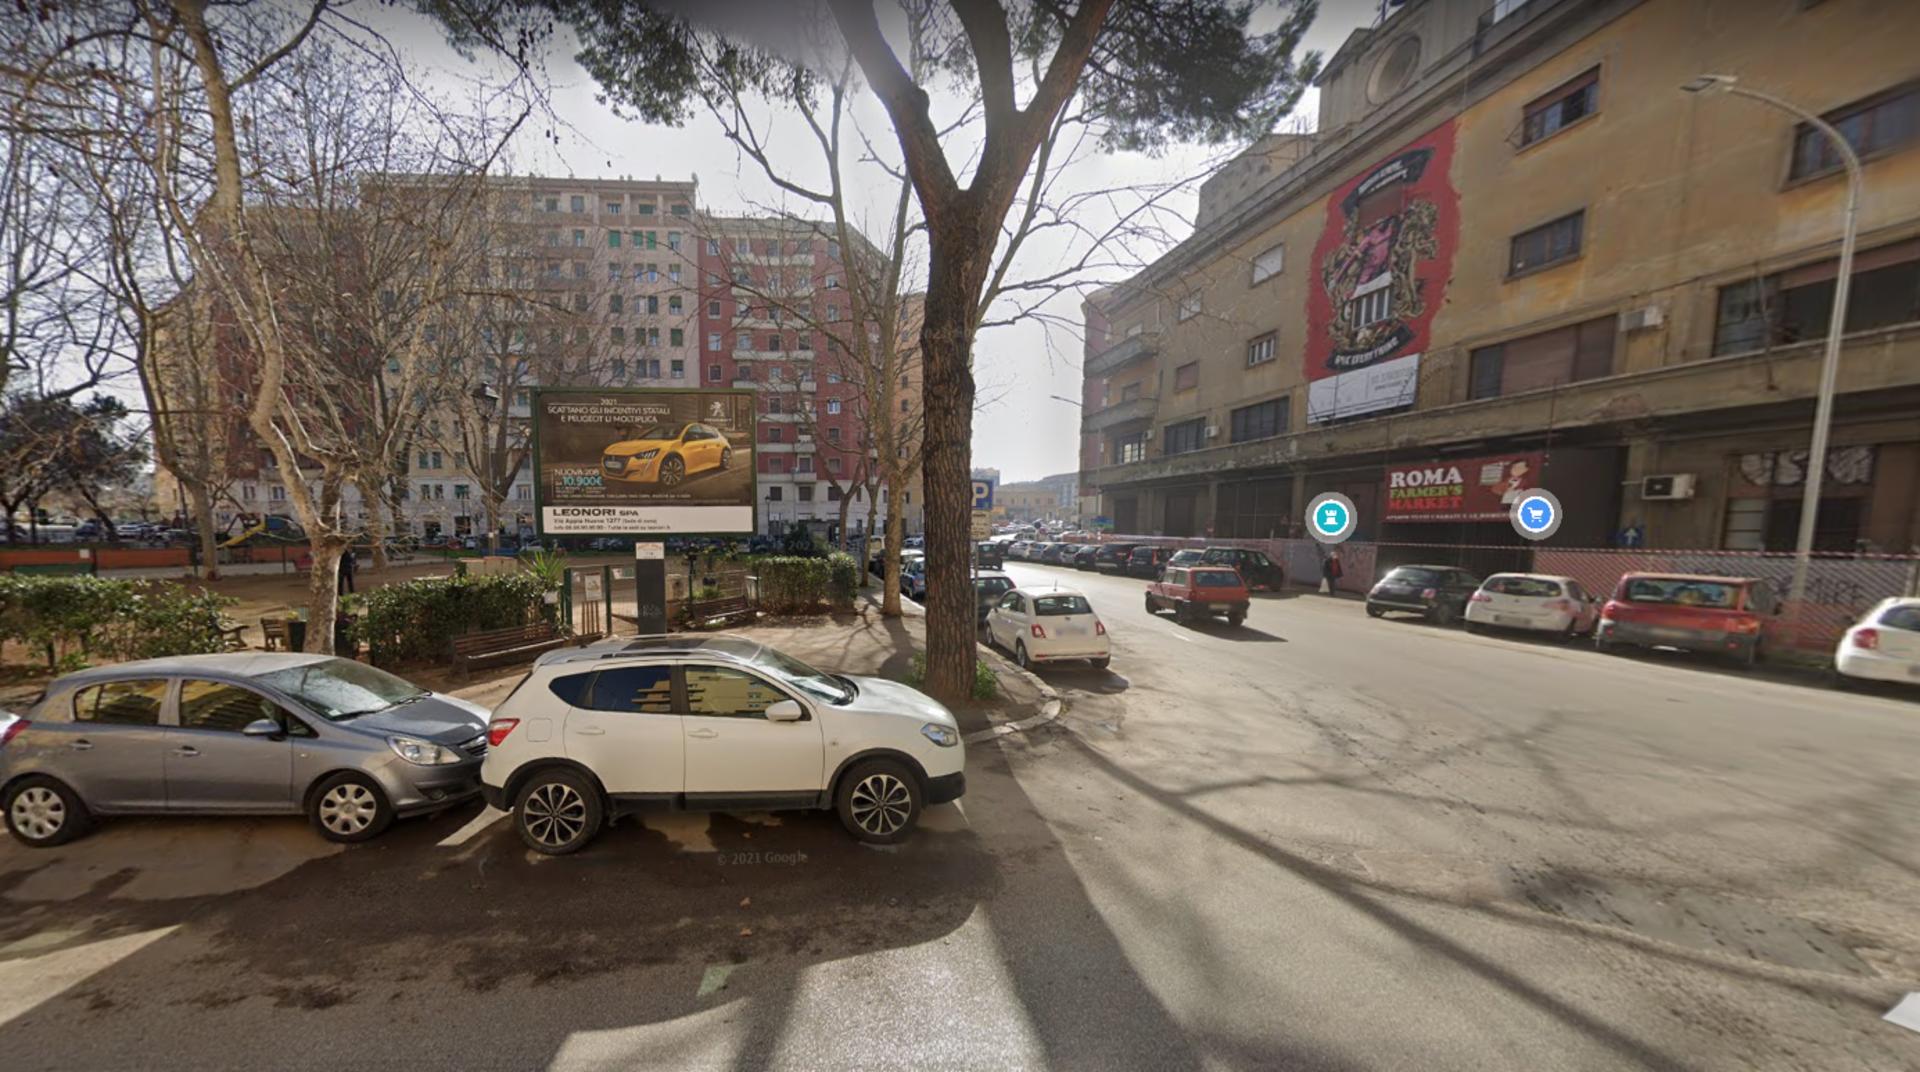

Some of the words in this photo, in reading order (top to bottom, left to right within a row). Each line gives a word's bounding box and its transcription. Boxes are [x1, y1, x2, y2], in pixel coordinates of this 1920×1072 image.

[547, 406, 589, 414] SCATTANO
[613, 415, 658, 423] MOLTIPLICA
[554, 468, 584, 476] NUOVA
[1390, 466, 1464, 488] ROMA
[971, 481, 989, 507] P
[1390, 485, 1464, 498] FARMER'S
[1389, 496, 1463, 510] MARKET
[553, 508, 616, 517] LEONORI
